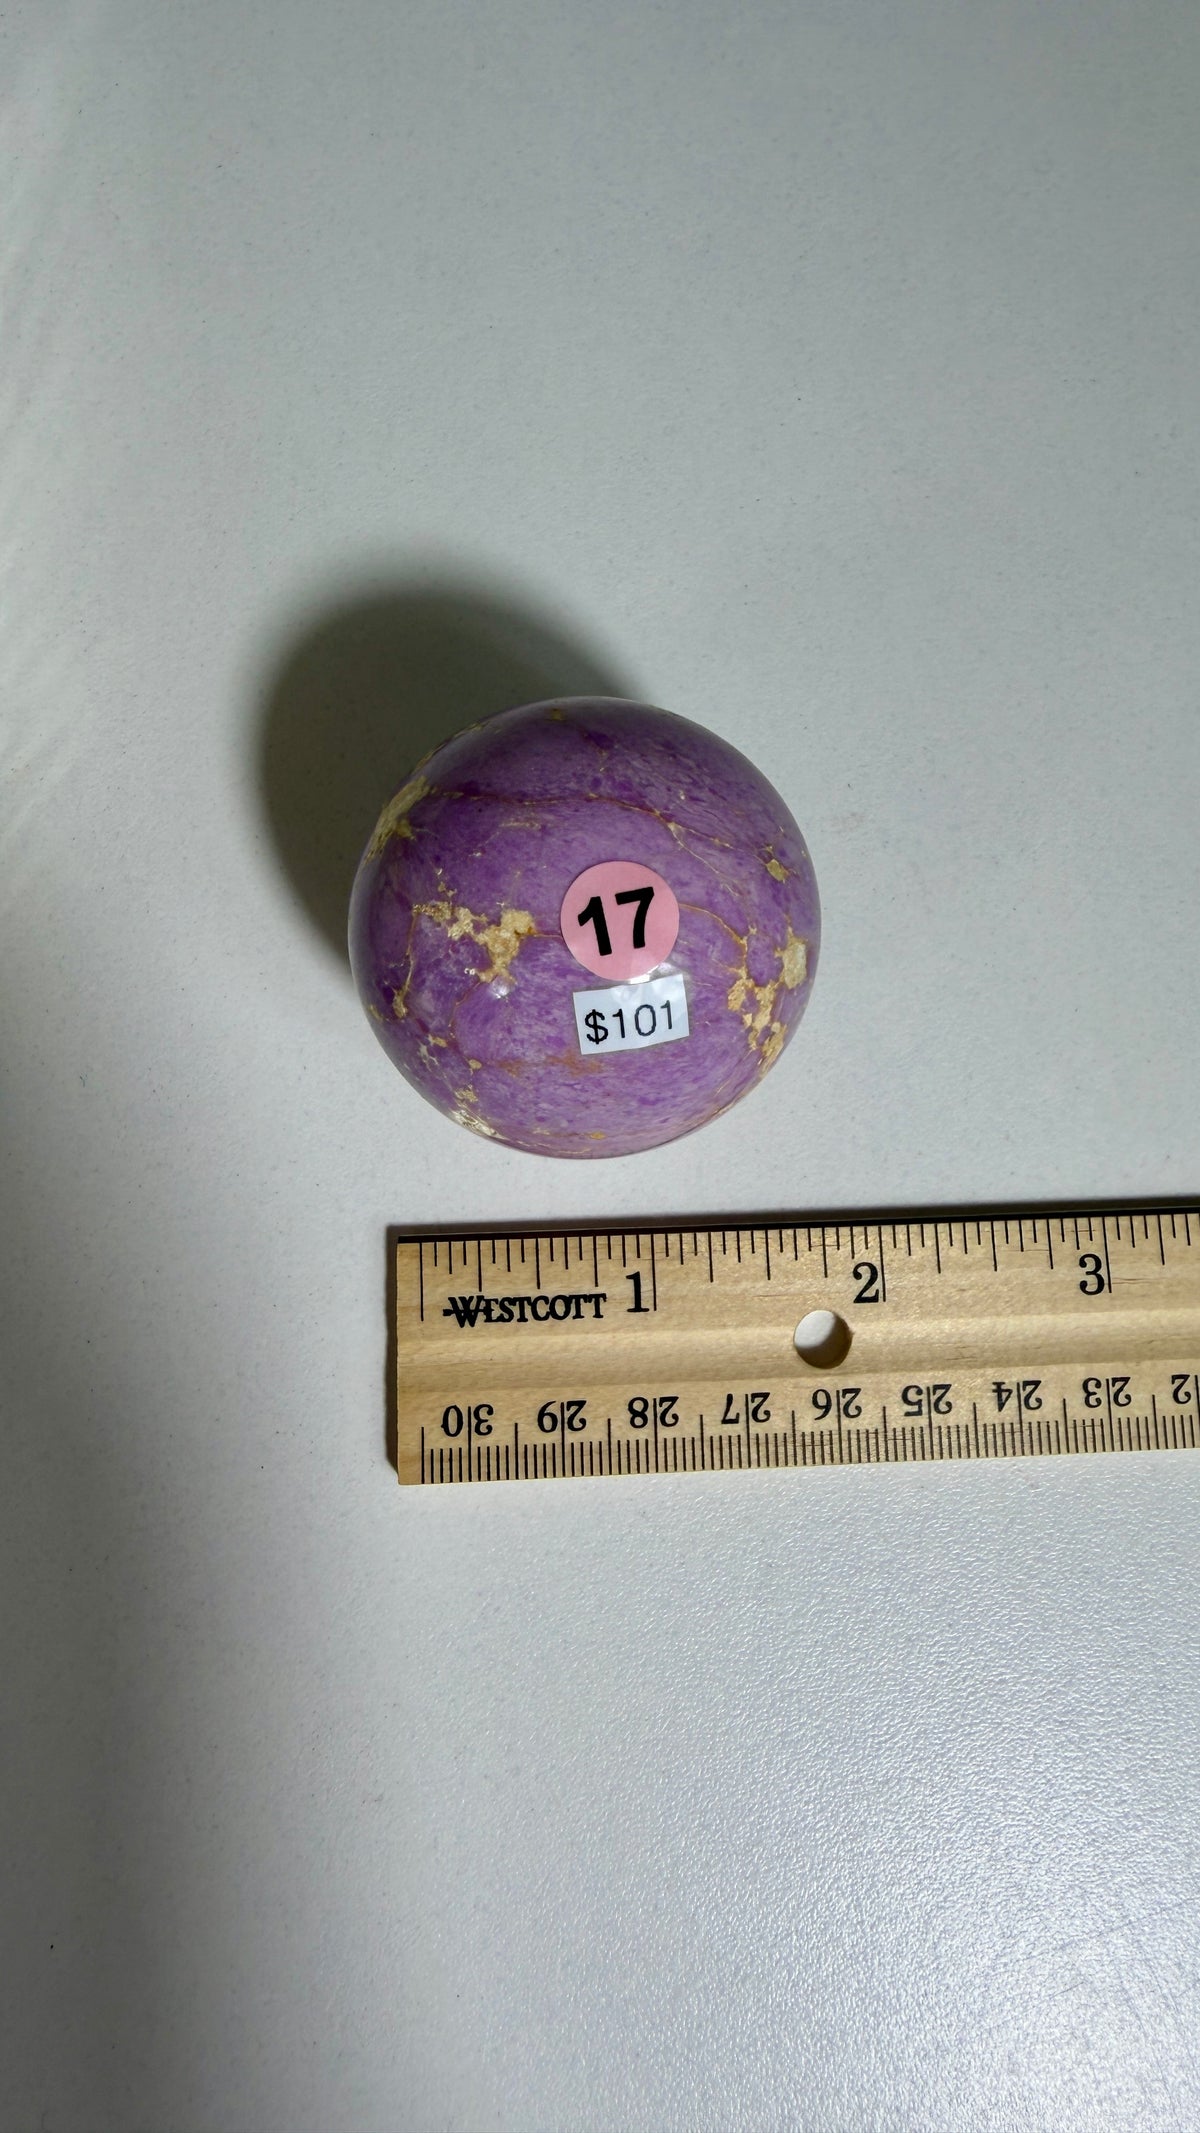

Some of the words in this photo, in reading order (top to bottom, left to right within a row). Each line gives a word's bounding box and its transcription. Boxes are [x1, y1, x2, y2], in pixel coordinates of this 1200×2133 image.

[577, 886, 655, 957] 17
[584, 1000, 673, 1045] $101
[625, 1270, 650, 1313] 1
[852, 1261, 880, 1304] 2
[1078, 1253, 1105, 1296] 3
[443, 1292, 607, 1328] WESTCOTT
[811, 1387, 863, 1420] 26
[901, 1383, 953, 1417] 25
[991, 1379, 1043, 1412] 24
[1081, 1376, 1132, 1408] 23
[1170, 1373, 1193, 1405] 2
[440, 1403, 495, 1438] 30
[536, 1400, 588, 1433] 29
[627, 1395, 680, 1429] 28
[720, 1391, 771, 1425] 27
